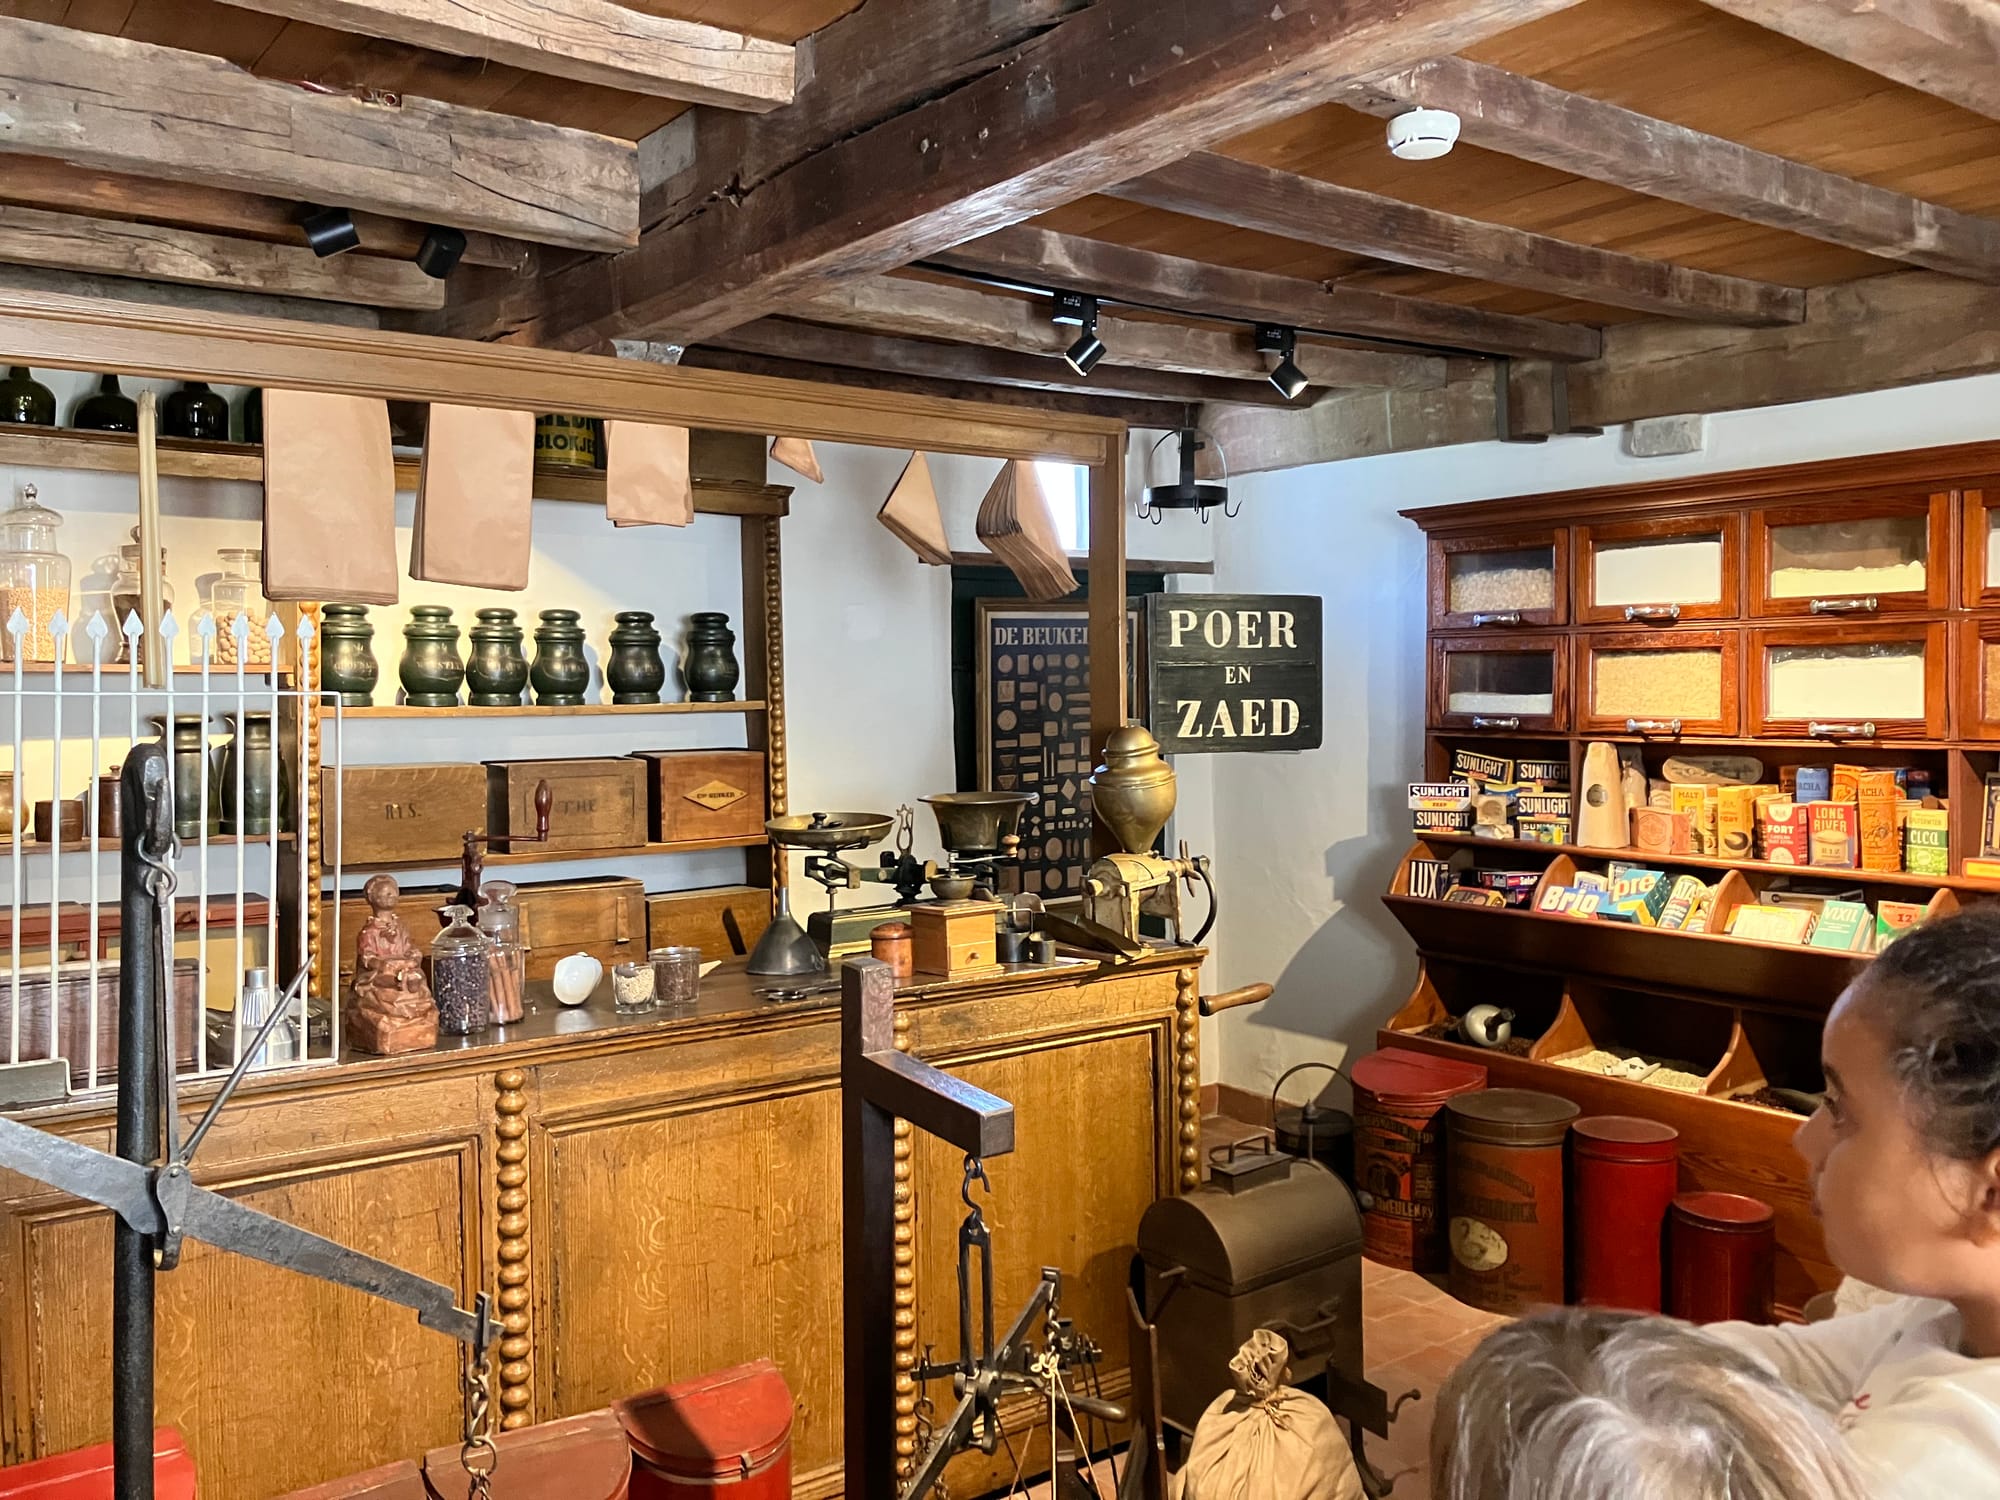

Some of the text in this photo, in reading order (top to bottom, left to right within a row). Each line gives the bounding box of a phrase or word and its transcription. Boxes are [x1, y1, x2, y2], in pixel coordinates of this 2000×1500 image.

[994, 627, 1018, 645] DE
[1169, 609, 1298, 649] POER
[1224, 666, 1251, 685] EN
[1175, 698, 1300, 738] ZAED
[1456, 753, 1504, 777] SUNLIGHT
[1411, 786, 1467, 798] SUNLIGHT
[1416, 812, 1471, 827] SUNLIGHT
[1815, 807, 1845, 820] LONG
[1767, 824, 1795, 834] FORT
[1813, 819, 1848, 832] RIVER
[1410, 861, 1438, 899] LUX
[1540, 885, 1600, 912] Brio
